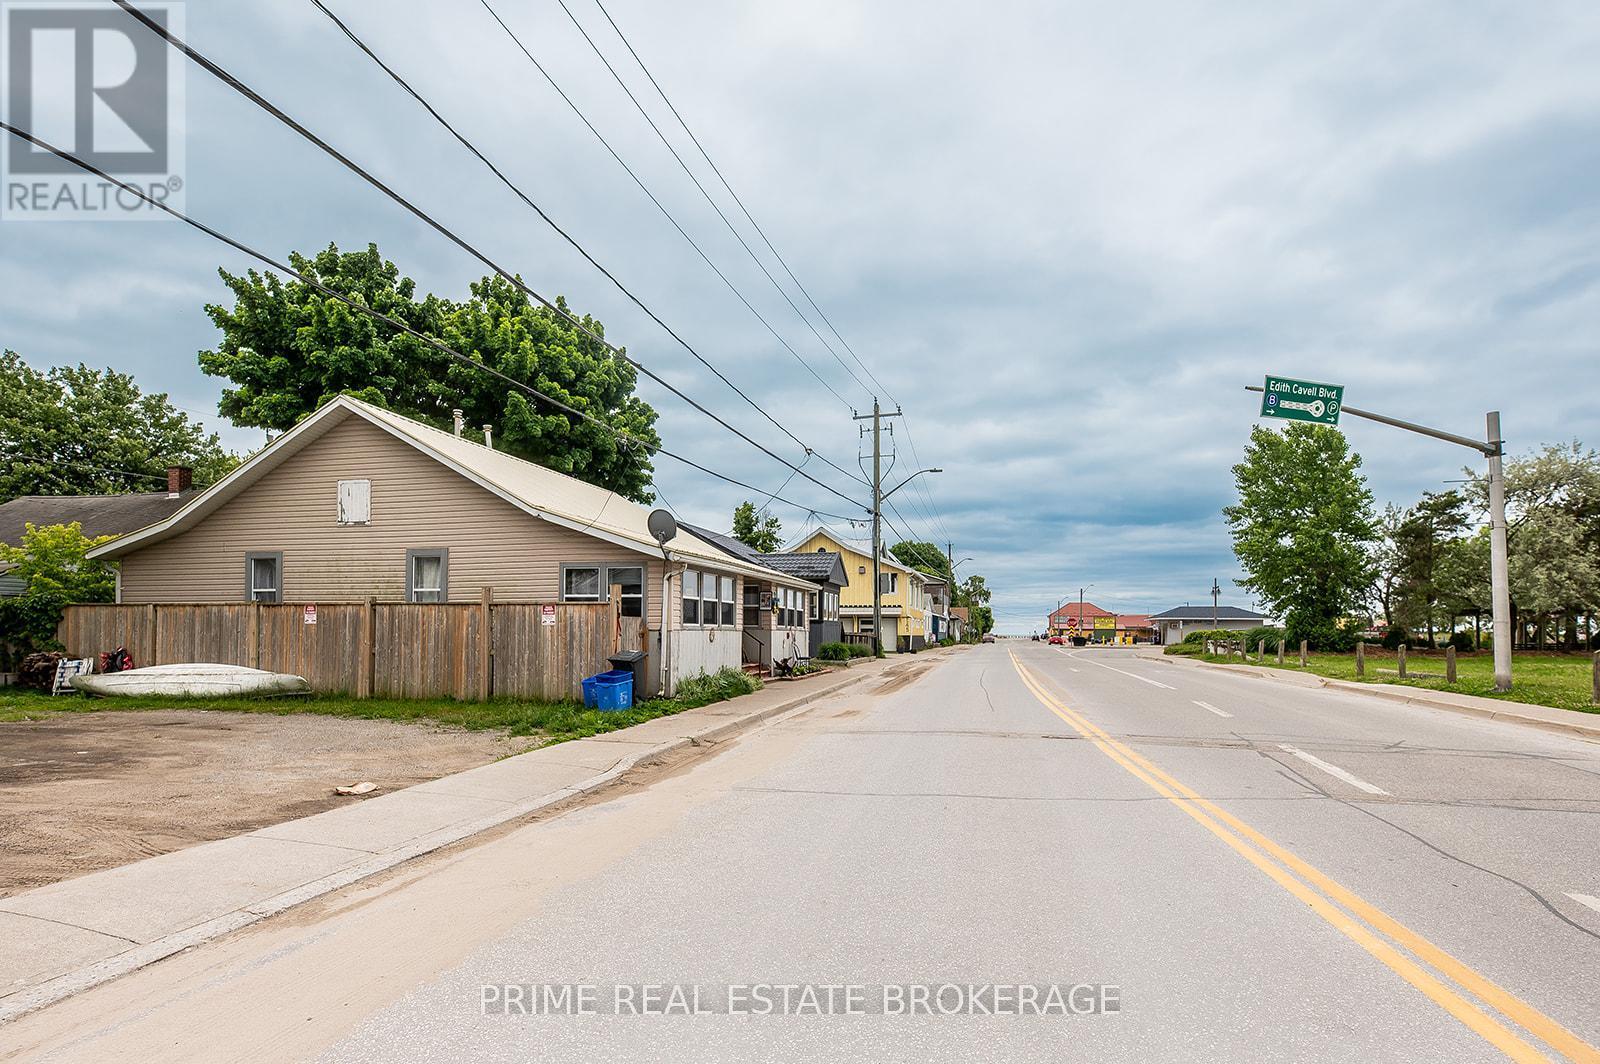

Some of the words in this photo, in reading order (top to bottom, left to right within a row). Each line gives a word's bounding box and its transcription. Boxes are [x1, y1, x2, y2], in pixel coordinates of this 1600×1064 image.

[1269, 380, 1291, 392] Edith
[1292, 384, 1317, 396] Cavell
[1318, 387, 1338, 399] Blvd.
[1269, 395, 1276, 405] B
[1330, 404, 1337, 413] P
